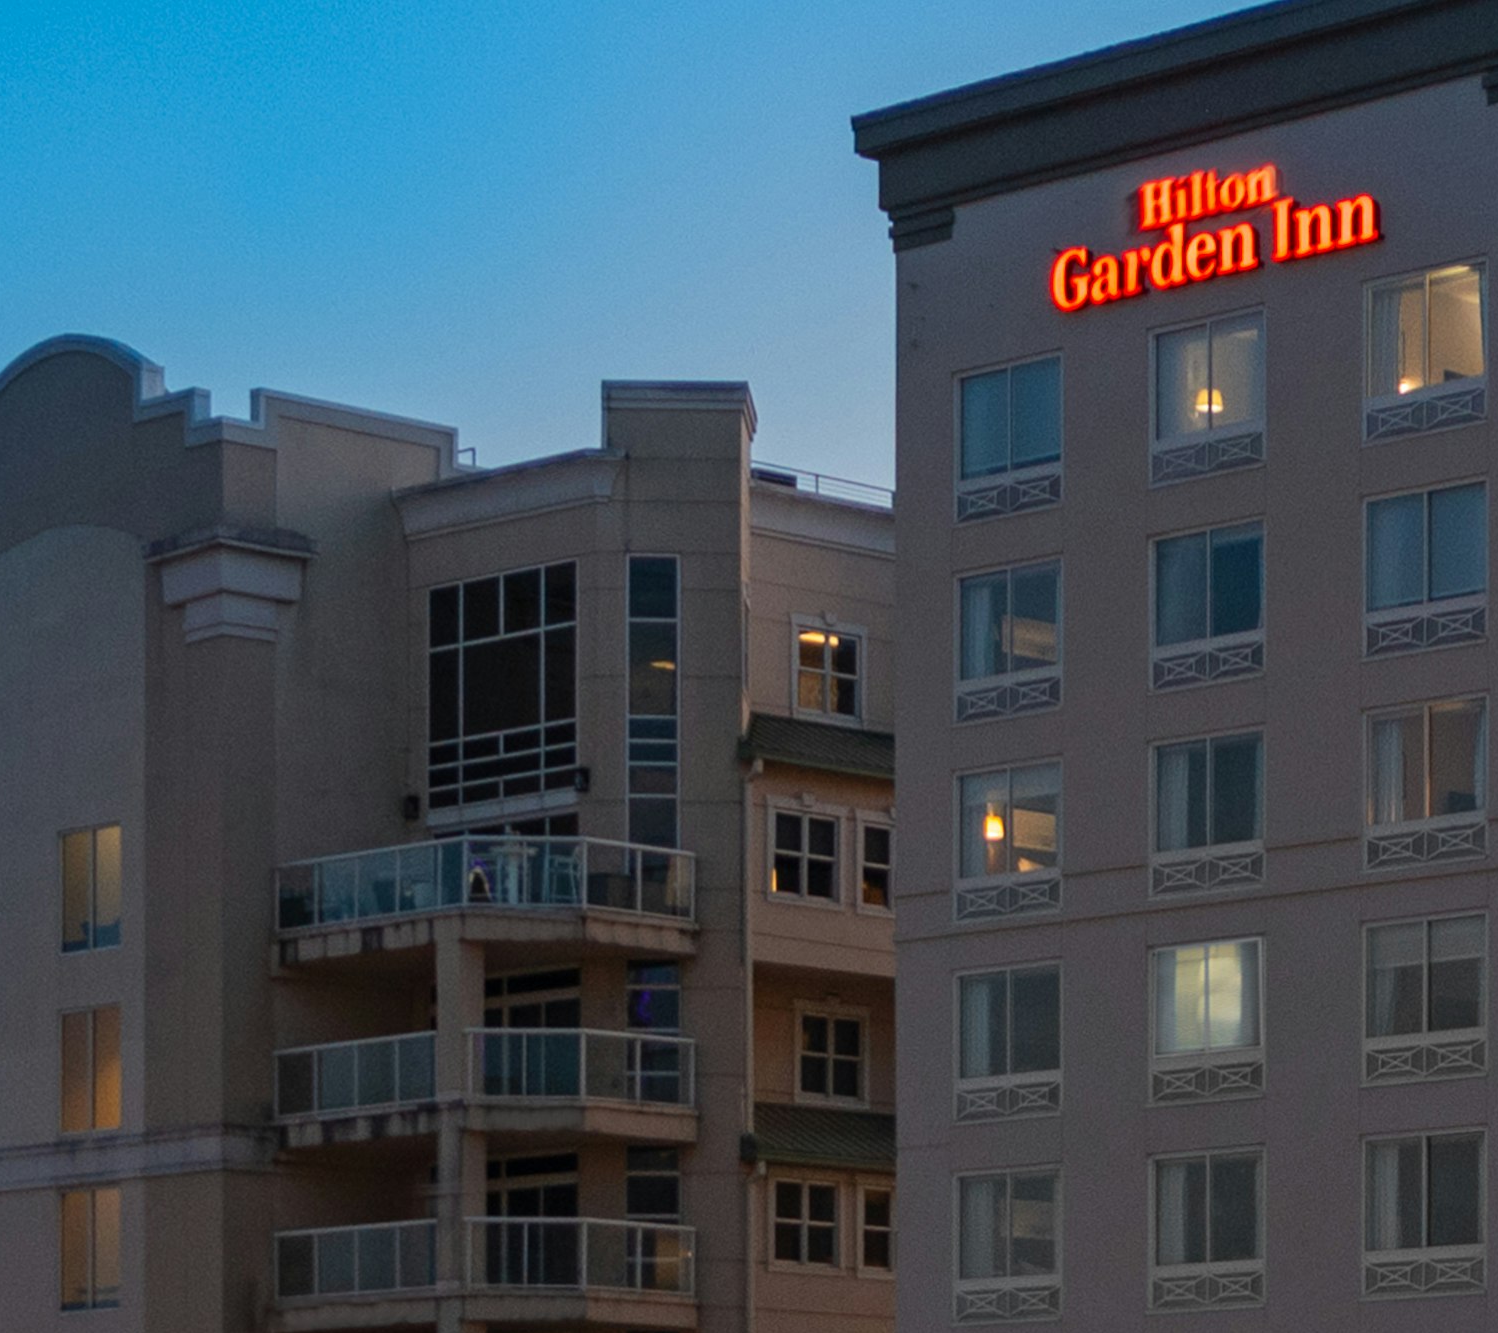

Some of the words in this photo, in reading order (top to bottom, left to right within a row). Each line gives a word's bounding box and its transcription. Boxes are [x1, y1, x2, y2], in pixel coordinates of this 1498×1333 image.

[1138, 163, 1278, 231] Hilton
[1050, 222, 1259, 312] Garden
[1270, 192, 1381, 264] Inn
